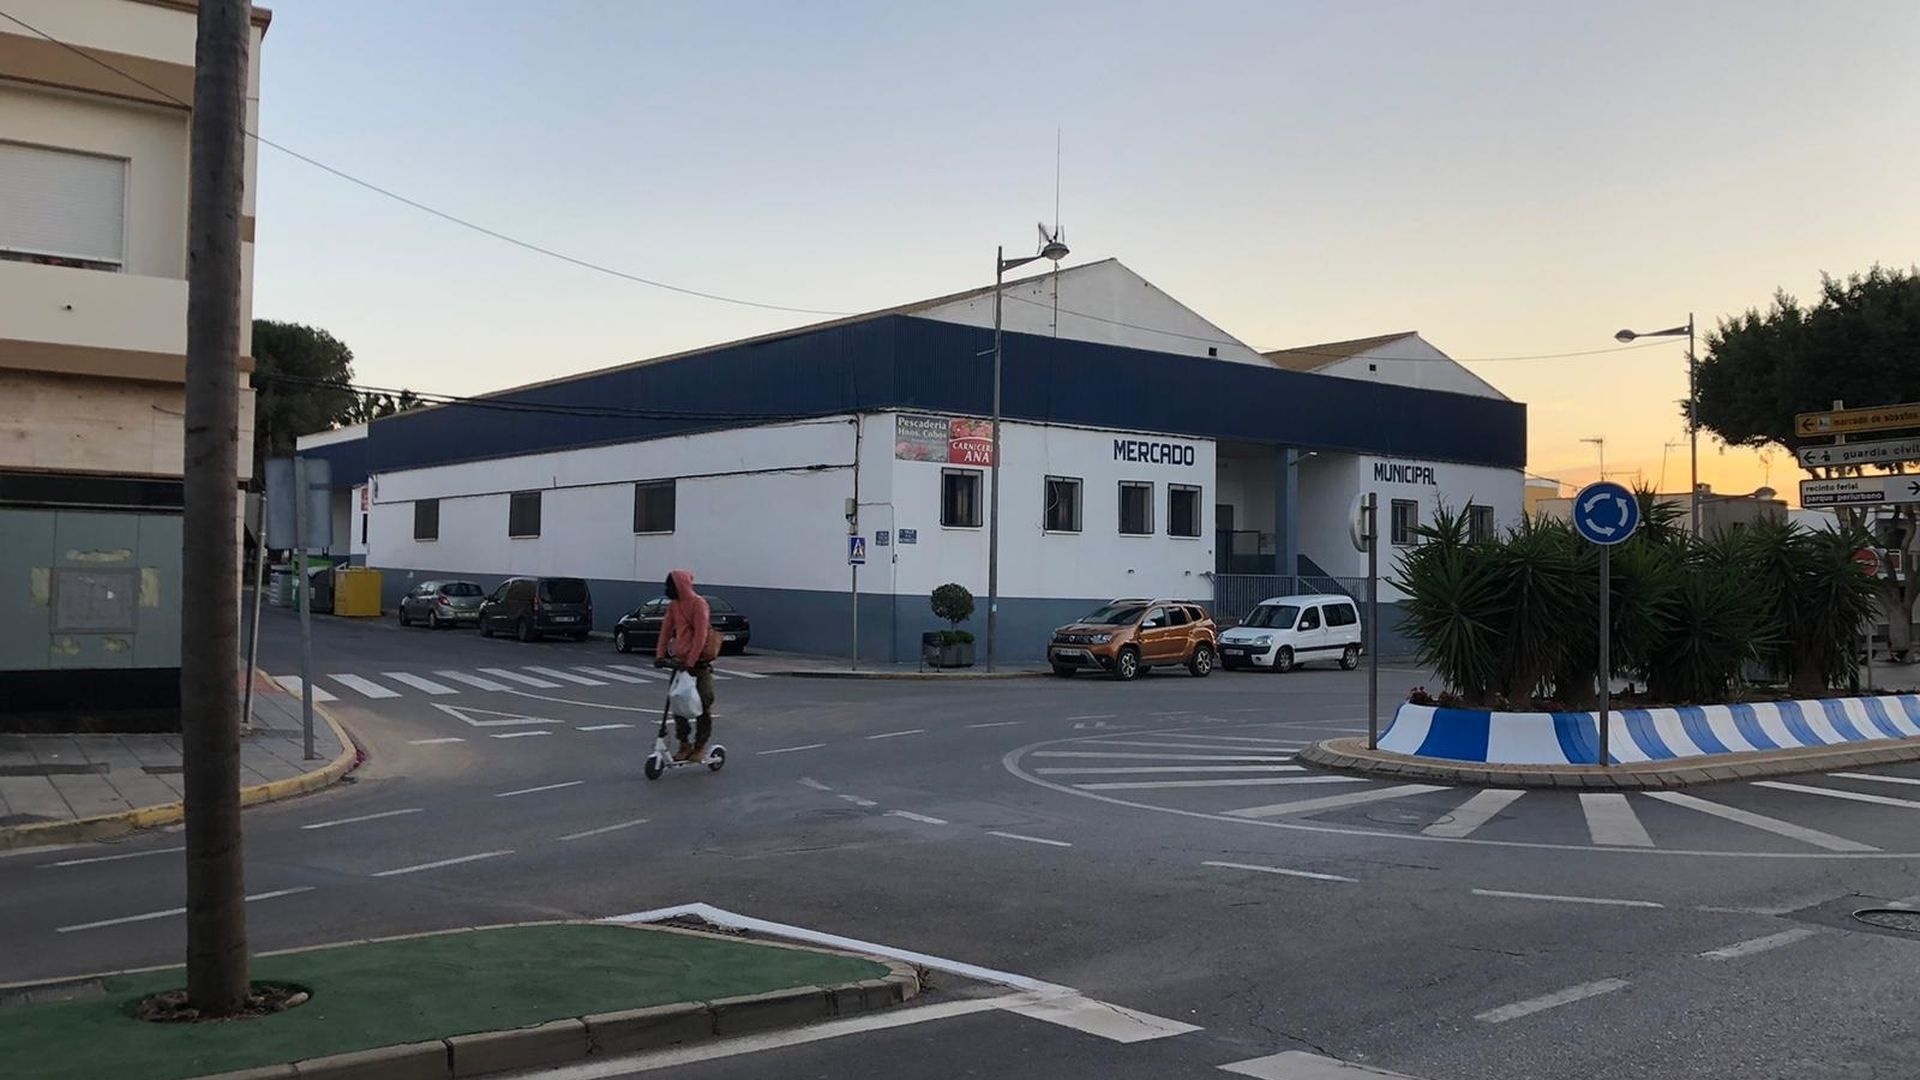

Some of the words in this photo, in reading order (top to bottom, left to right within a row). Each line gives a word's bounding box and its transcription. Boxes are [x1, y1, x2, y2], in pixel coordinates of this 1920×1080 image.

[964, 450, 990, 463] ANA
[1113, 439, 1195, 466] MERCADO
[1843, 448, 1887, 460] guardia
[1894, 442, 1920, 455] civil
[1374, 462, 1437, 485] MUNICIPAL
[1806, 483, 1835, 492] recinto
[1836, 482, 1859, 491] ferial
[1806, 494, 1834, 503] parque
[1837, 492, 1882, 502] periurbano
